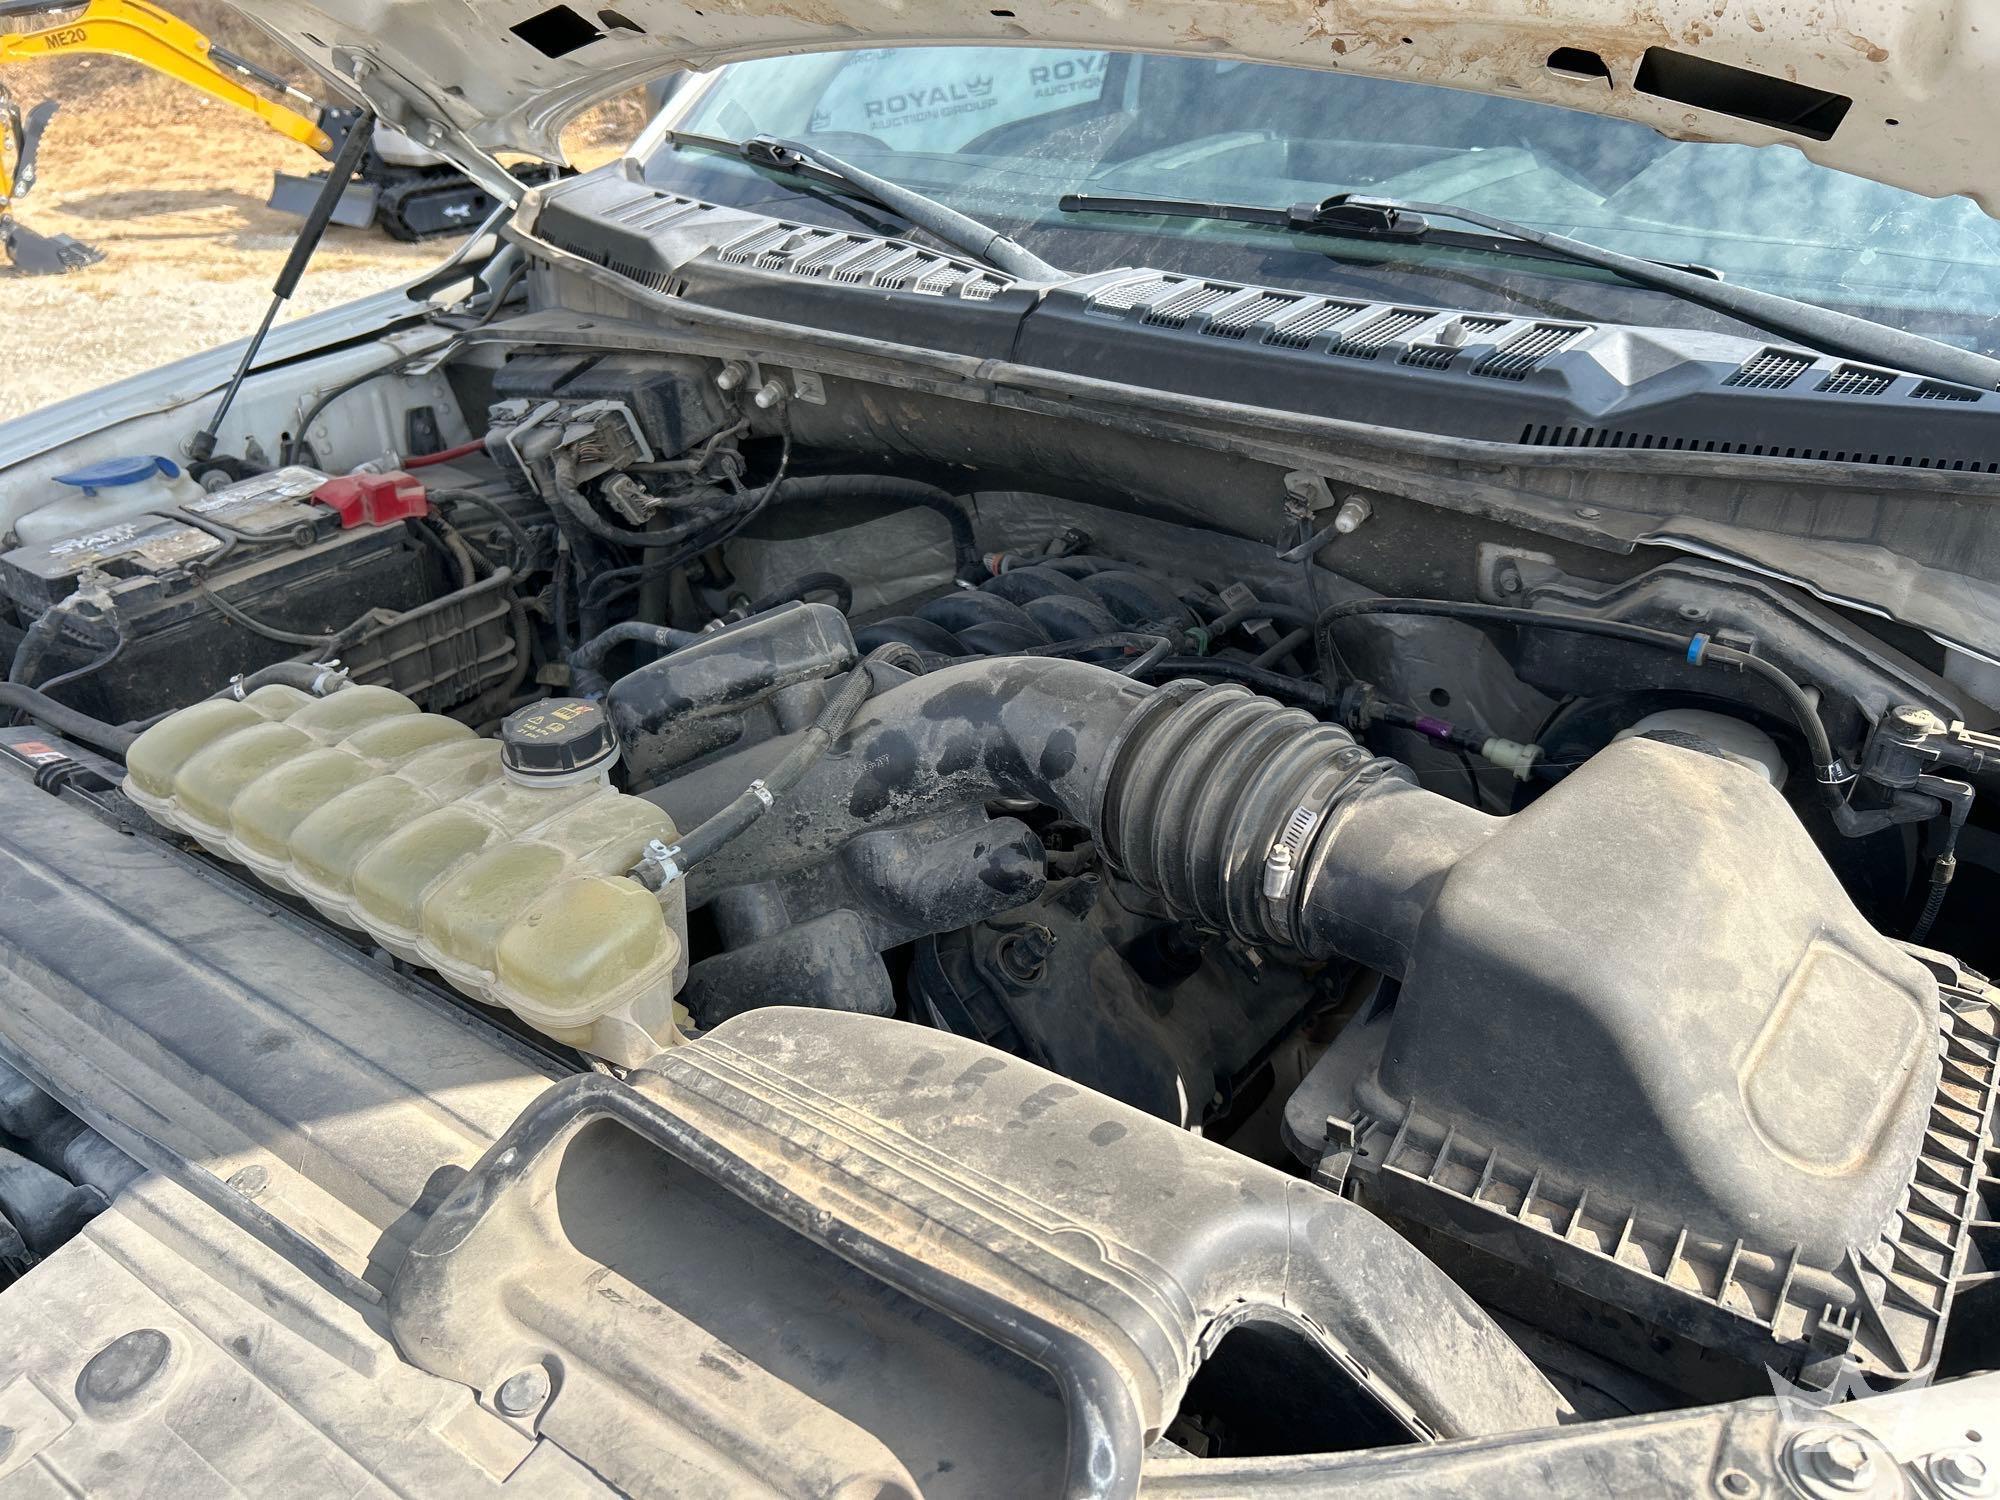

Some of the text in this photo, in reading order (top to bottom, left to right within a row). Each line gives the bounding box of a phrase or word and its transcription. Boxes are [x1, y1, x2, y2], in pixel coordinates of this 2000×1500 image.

[44, 28, 87, 49] ME20
[864, 83, 969, 118] ROYAL
[870, 98, 998, 130] AUCTION GROUP
